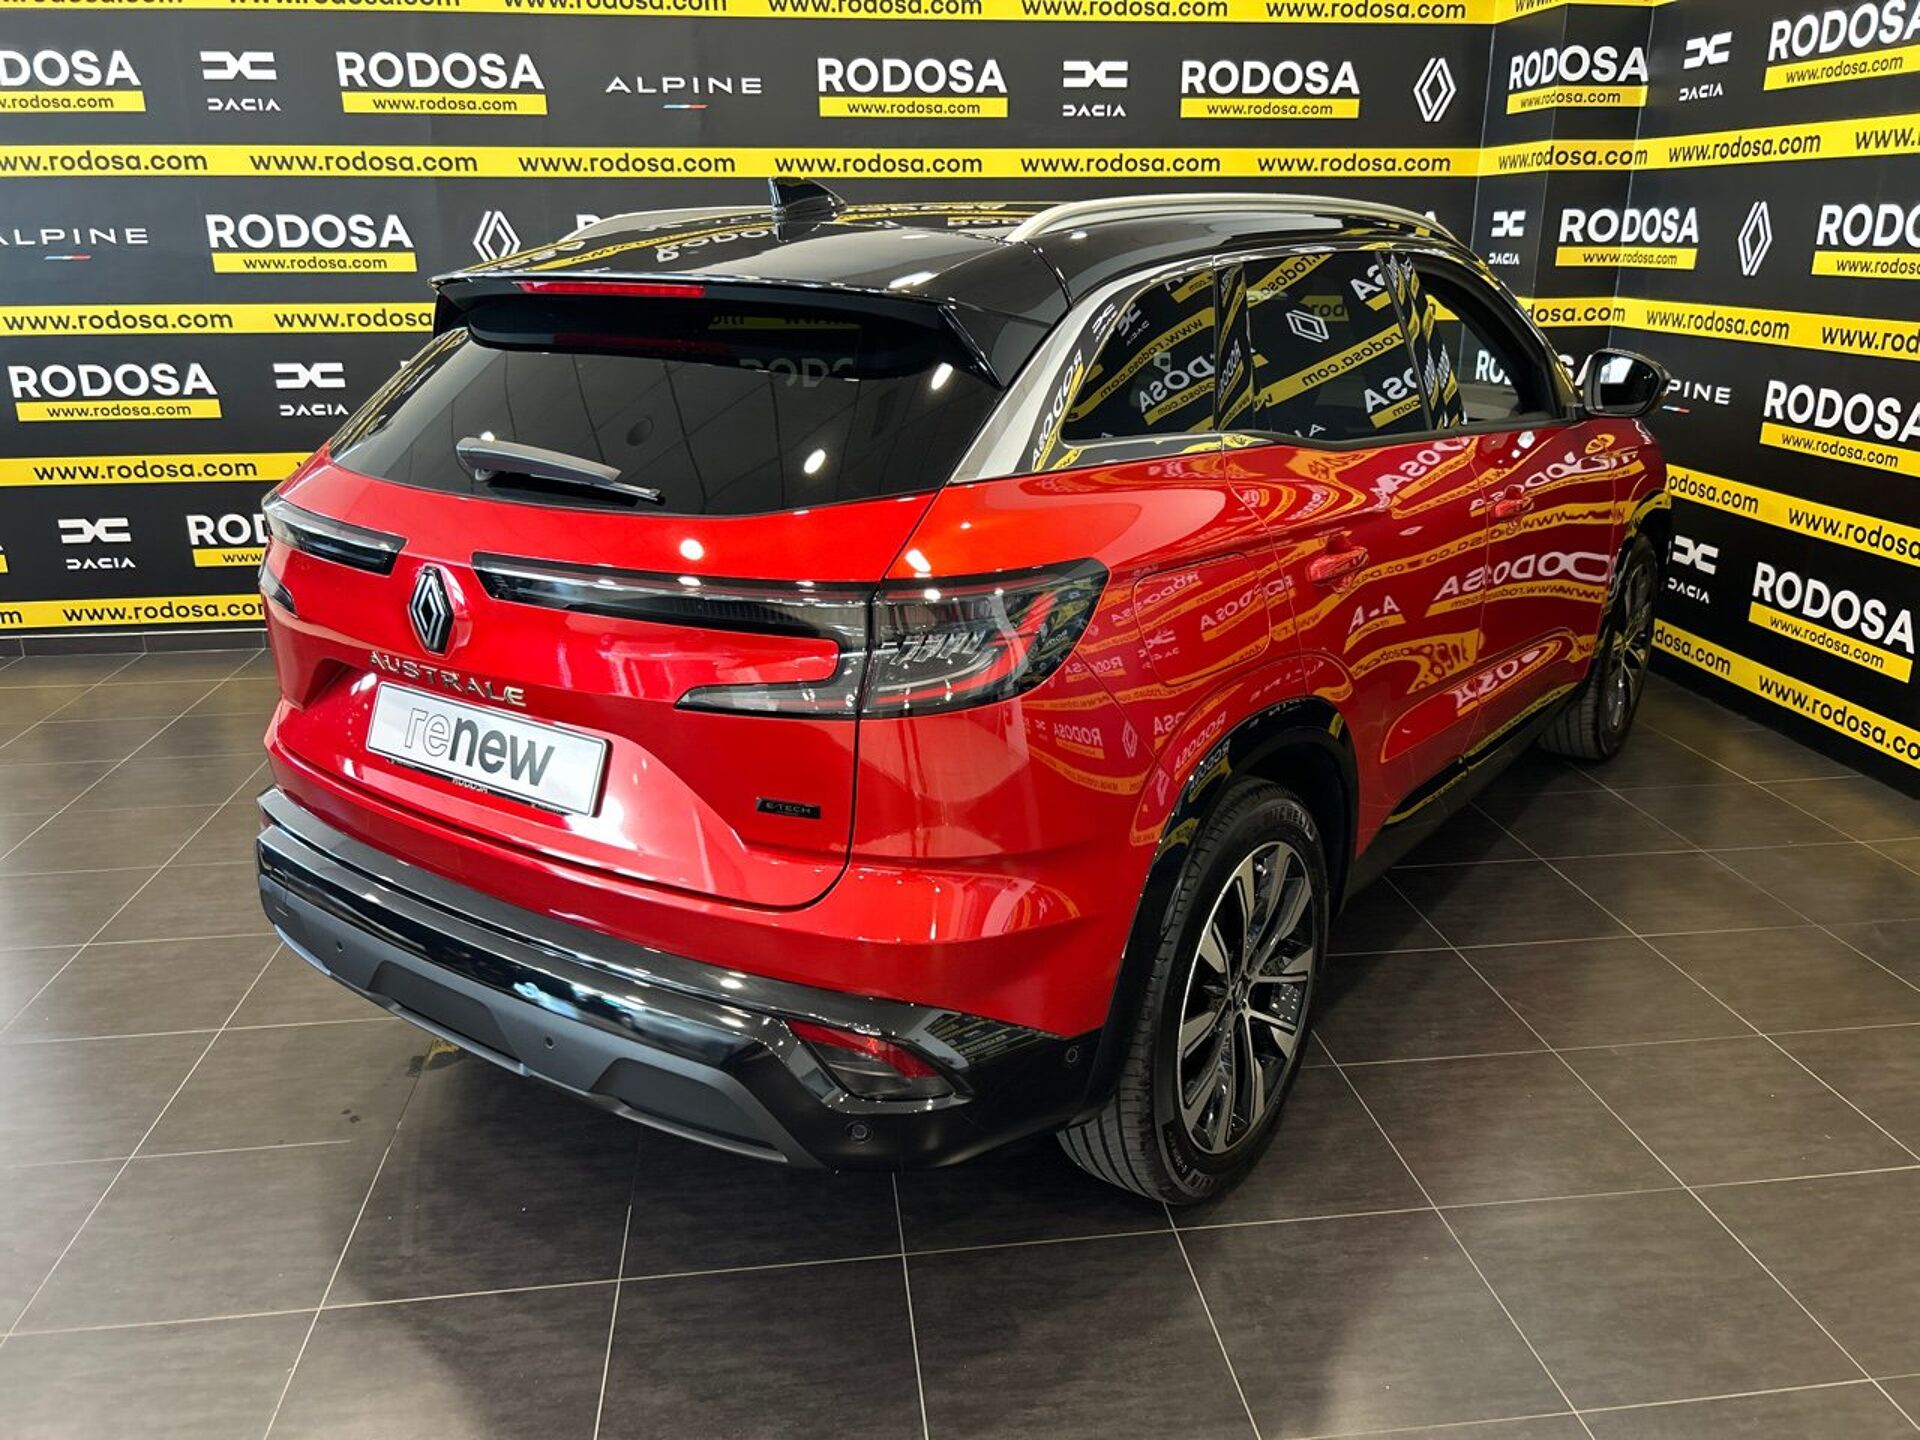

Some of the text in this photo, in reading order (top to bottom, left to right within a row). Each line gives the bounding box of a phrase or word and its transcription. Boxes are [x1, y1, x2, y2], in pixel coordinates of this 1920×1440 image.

[1023, 0, 1229, 18] www.rodosa.com
[1265, 0, 1467, 19] www.rodosa.com
[0, 49, 142, 87] DOSA
[335, 51, 544, 89] RODOSA
[817, 58, 1007, 95] RODOSA
[1181, 60, 1360, 95] RODOSA
[1508, 45, 1649, 91] RODOSA
[1785, 56, 1904, 84] www.rodosa.com
[605, 76, 763, 95] ALPINE
[1678, 83, 1724, 101] DACIA
[0, 95, 114, 109] .rodosa.com
[207, 97, 282, 112] DACIA
[372, 97, 518, 112] www.rodosa.com
[847, 101, 981, 117] www.rodosa.com
[1062, 103, 1127, 118] DACIA
[1206, 101, 1333, 117] www.rodosa.com
[1520, 90, 1621, 109] www.rodosa.com
[1498, 144, 1648, 170] www.rodosa.com
[1668, 131, 1821, 163] www.rodosa.com
[0, 150, 208, 172] ww.rodosa.com
[250, 151, 478, 173] www.rodosa.com
[518, 152, 736, 174] www.rodosa.com
[774, 152, 983, 174] www.rodosa.com
[1020, 153, 1221, 173] www.rodosa.com
[1257, 153, 1452, 173] www.rodosa.com
[205, 214, 414, 249] RODOSA
[1558, 207, 1699, 244] RODOSA
[243, 255, 388, 270] www.rodosa.com
[1488, 252, 1520, 266] DACIA
[1582, 249, 1678, 266] www.rodosa.com
[3, 311, 234, 333] www.rodosa.com
[273, 308, 433, 328] www.rodosa
[1646, 307, 1790, 340] www.rodosa.com
[8, 362, 218, 398] RODOSA
[1662, 379, 1732, 405] PINE
[46, 404, 192, 418] www.rodosa.com
[279, 404, 349, 417] DACIA
[1780, 432, 1899, 468] www.rodosa.com
[34, 460, 258, 481] www.rodosa.com
[1788, 507, 1920, 560] www.rodosa
[66, 557, 136, 570] DACIA
[1668, 577, 1710, 605] DACIA
[1751, 561, 1915, 655] RODOSA
[1769, 615, 1885, 669] www.rodosa.com
[370, 650, 527, 708] AUSTRALE
[1758, 675, 1920, 761] www.rodosa.co
[404, 707, 556, 787] renew
